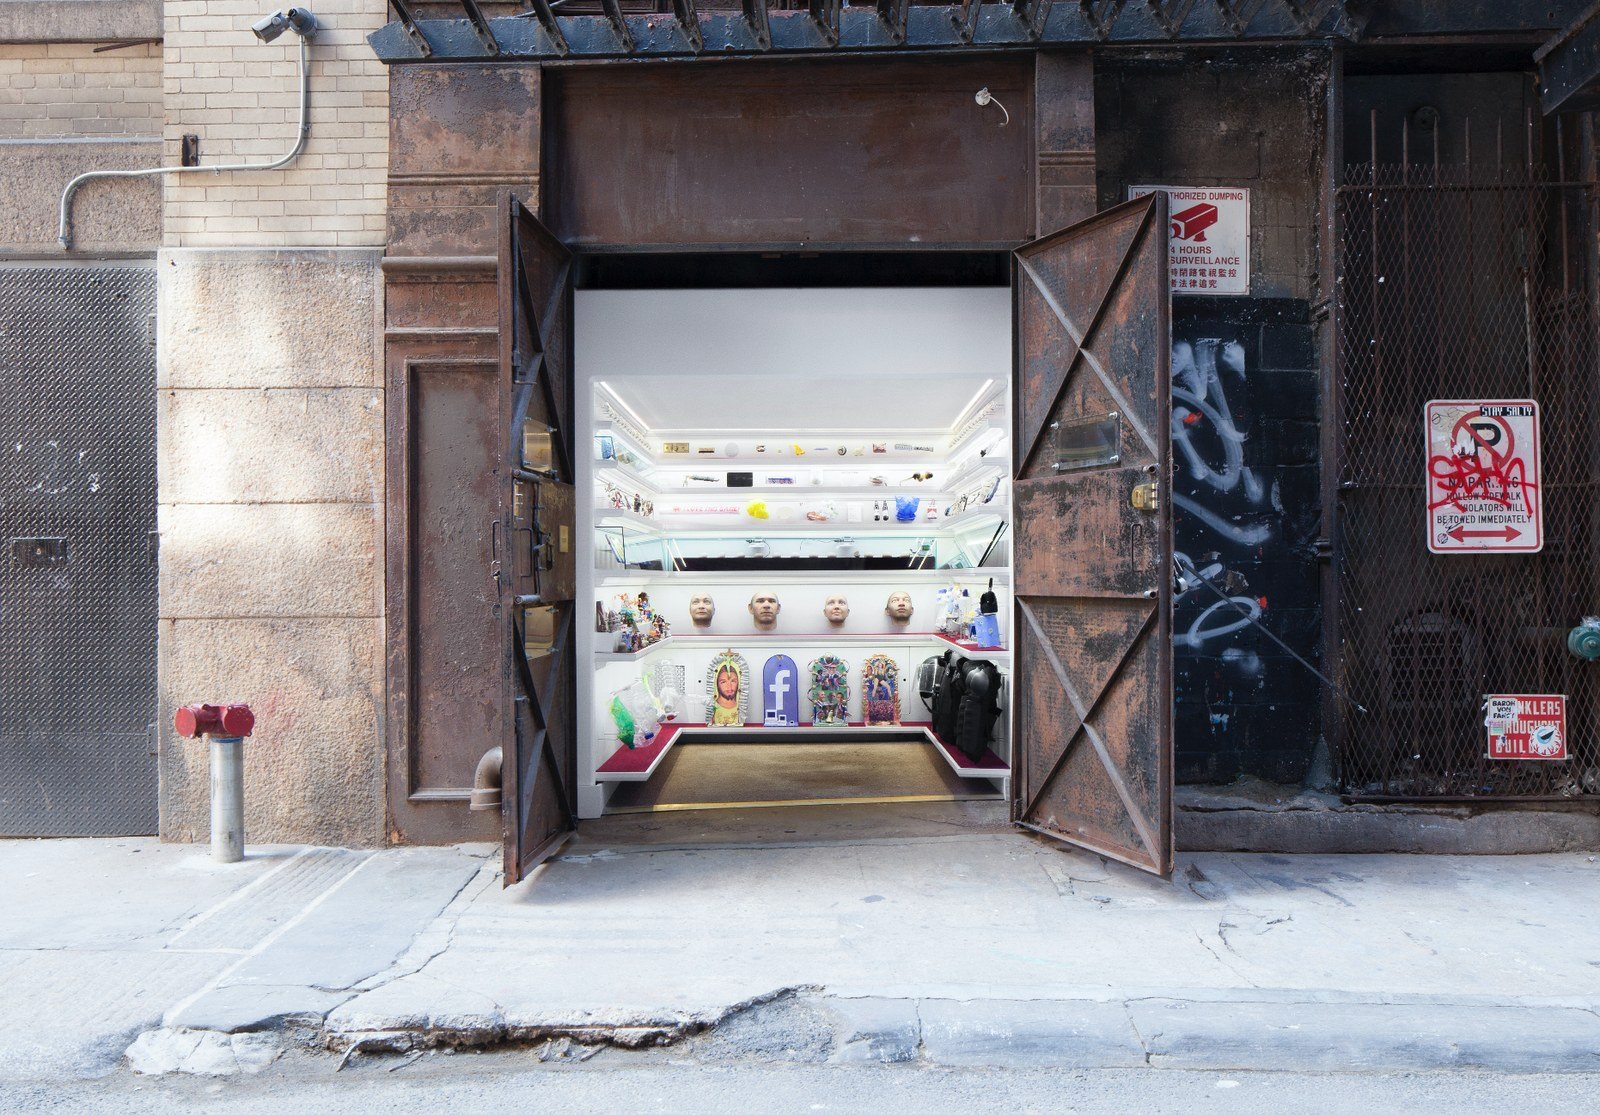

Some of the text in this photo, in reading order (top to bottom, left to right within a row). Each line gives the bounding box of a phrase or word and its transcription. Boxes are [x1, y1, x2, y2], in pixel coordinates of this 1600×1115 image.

[1209, 192, 1243, 201] DUMPING
[1180, 246, 1212, 254] HOURS
[1171, 256, 1240, 265] SURVEILLANCE
[1481, 407, 1533, 417] STAY SALTY
[1506, 503, 1525, 512] WILL
[1437, 514, 1532, 524] BE TOWED IMMEDIATELY
[769, 670, 791, 710] f
